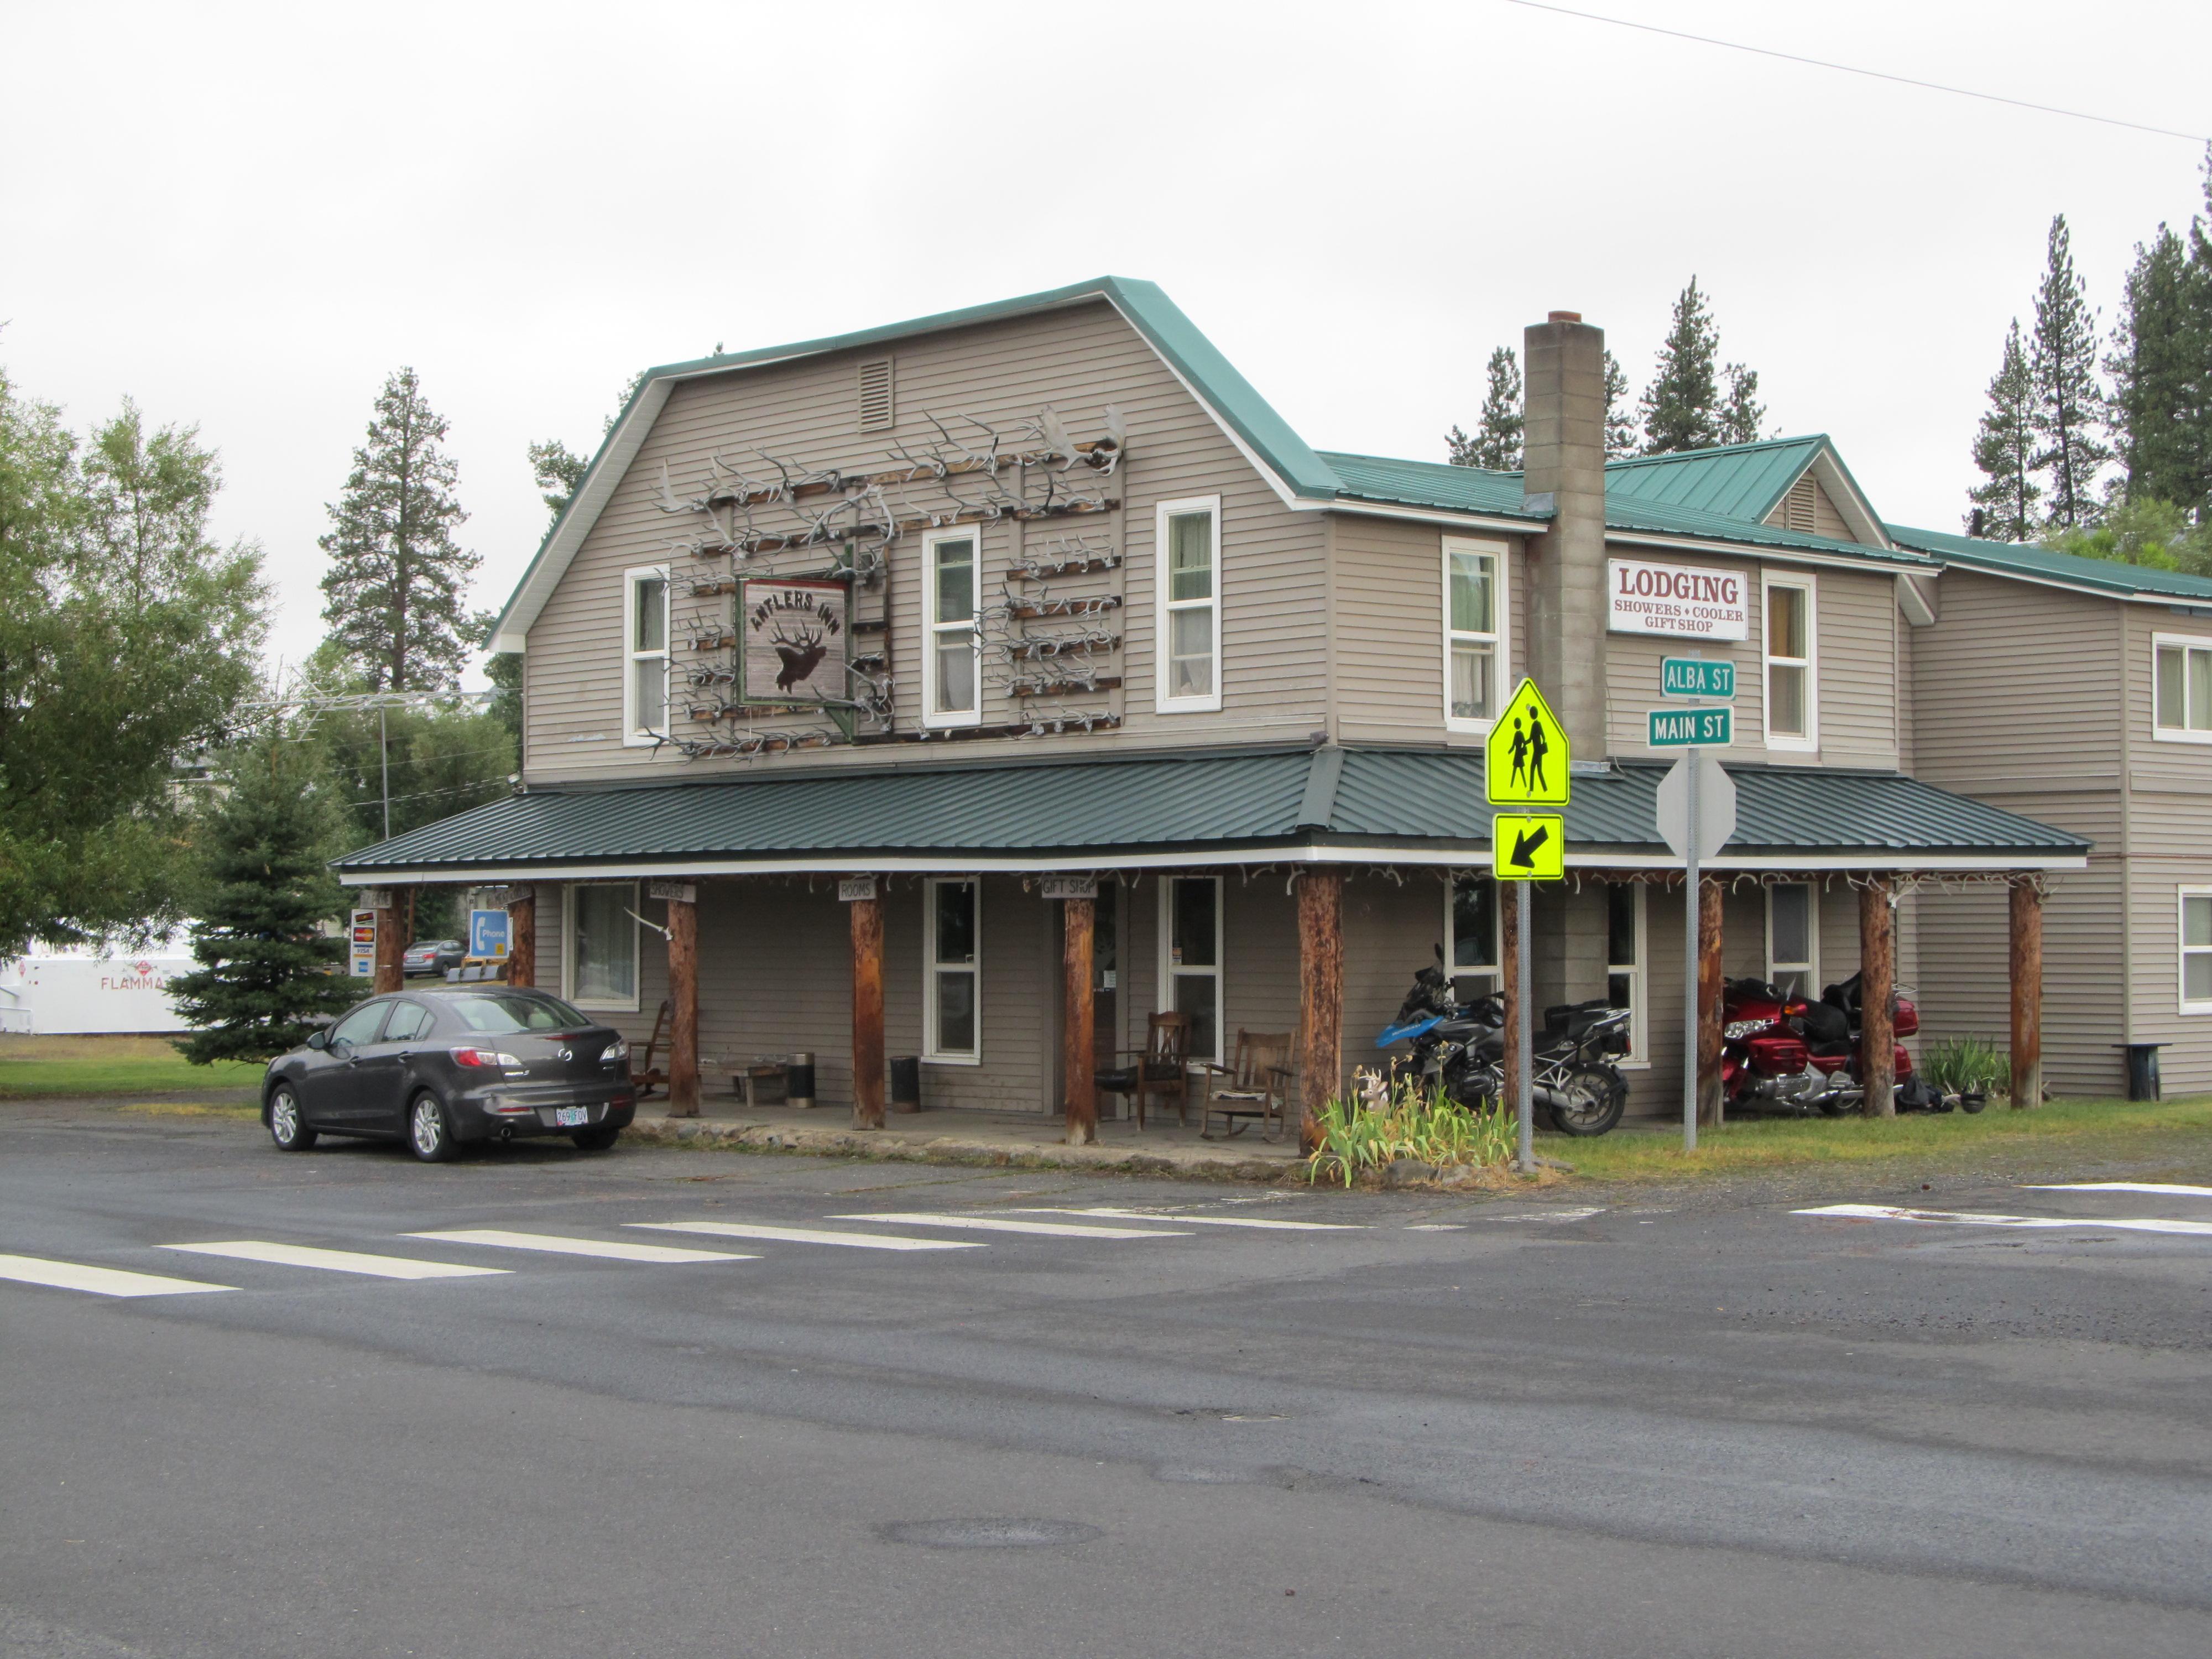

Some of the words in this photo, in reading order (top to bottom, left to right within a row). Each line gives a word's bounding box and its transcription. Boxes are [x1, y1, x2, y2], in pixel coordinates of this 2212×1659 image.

[1619, 567, 1739, 604] LODGING
[750, 590, 813, 632] ANTLERS
[817, 602, 840, 636] INN
[1615, 599, 1682, 616] SHOWERS
[1693, 607, 1744, 622] COOLER
[1645, 617, 1676, 629] GIFT
[1678, 619, 1713, 632] SHOP
[1667, 666, 1706, 690] ALBA
[1713, 669, 1730, 691] ST
[1655, 717, 1695, 740] MAIN
[1704, 716, 1724, 738] ST
[841, 883, 871, 897] ROOMS
[1043, 879, 1066, 894] GIFT
[558, 1111, 570, 1122] 269
